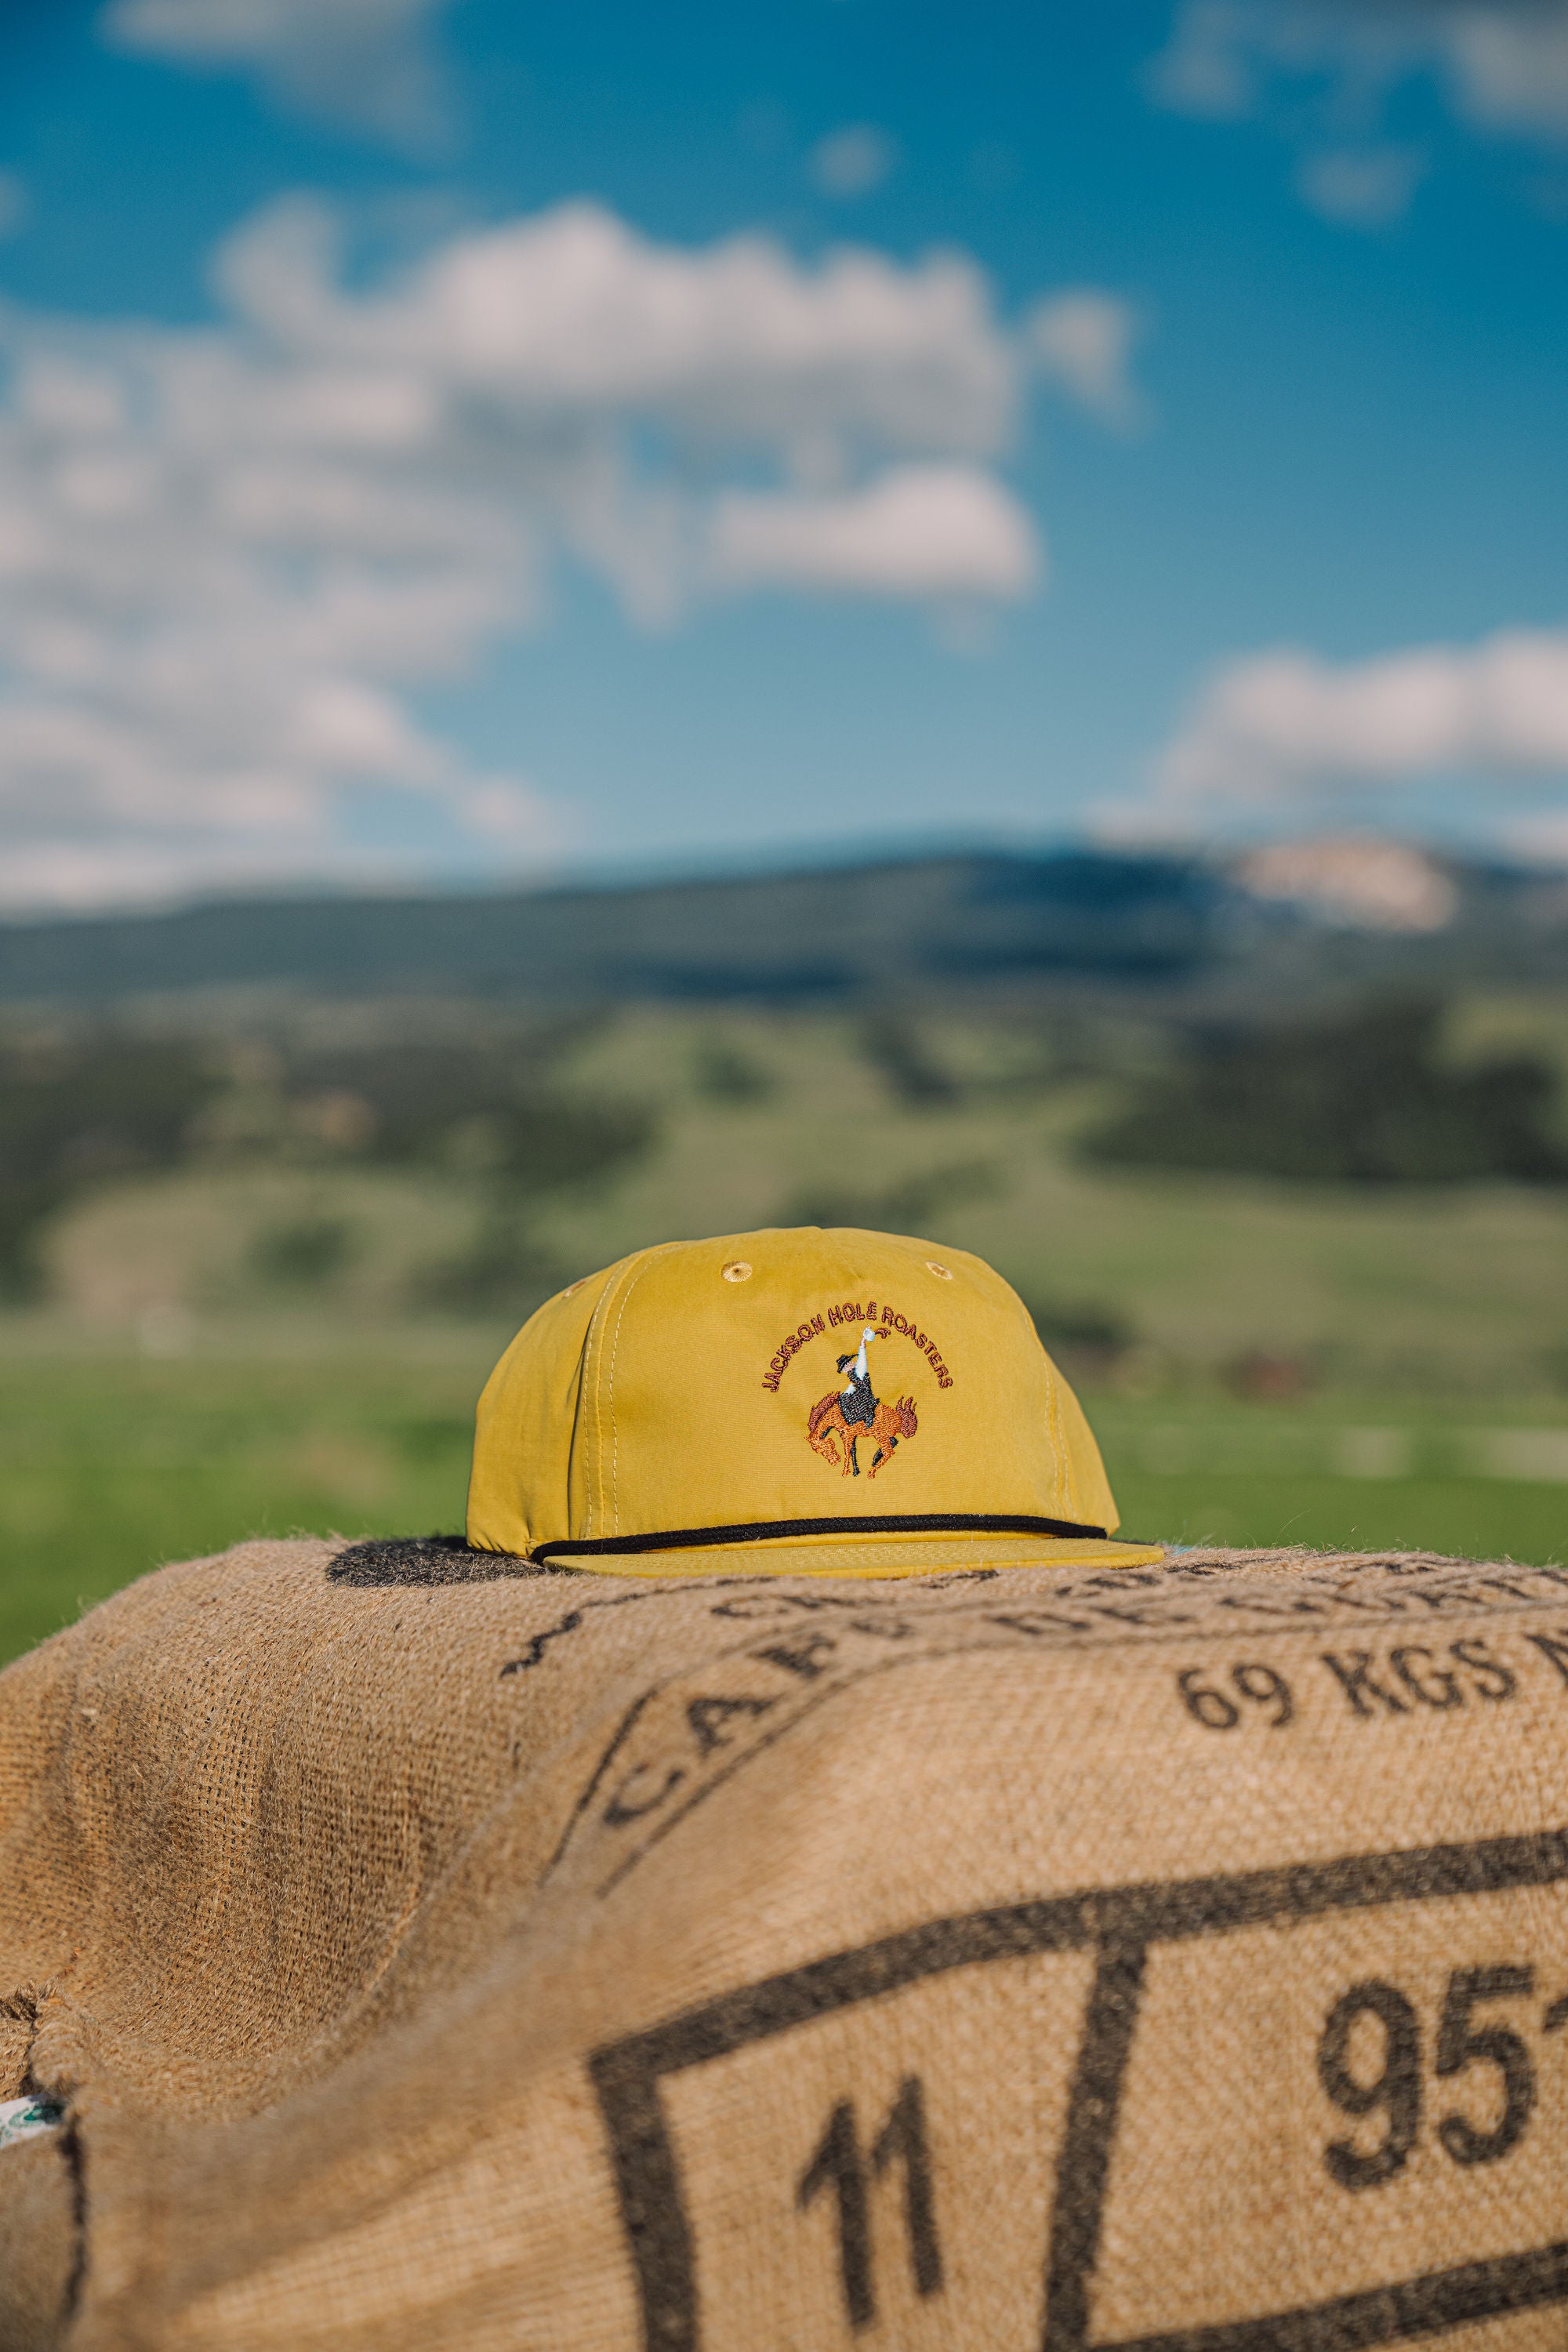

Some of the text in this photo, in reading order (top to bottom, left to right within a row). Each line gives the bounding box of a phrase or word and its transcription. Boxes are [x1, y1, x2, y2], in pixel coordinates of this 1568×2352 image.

[761, 1301, 953, 1393] JACKSON HOLE ROASTERS
[1178, 1663, 1297, 1730] 69
[1322, 1638, 1517, 1717] KGS
[1317, 1963, 1568, 2193] 95
[795, 2073, 946, 2331] 11
